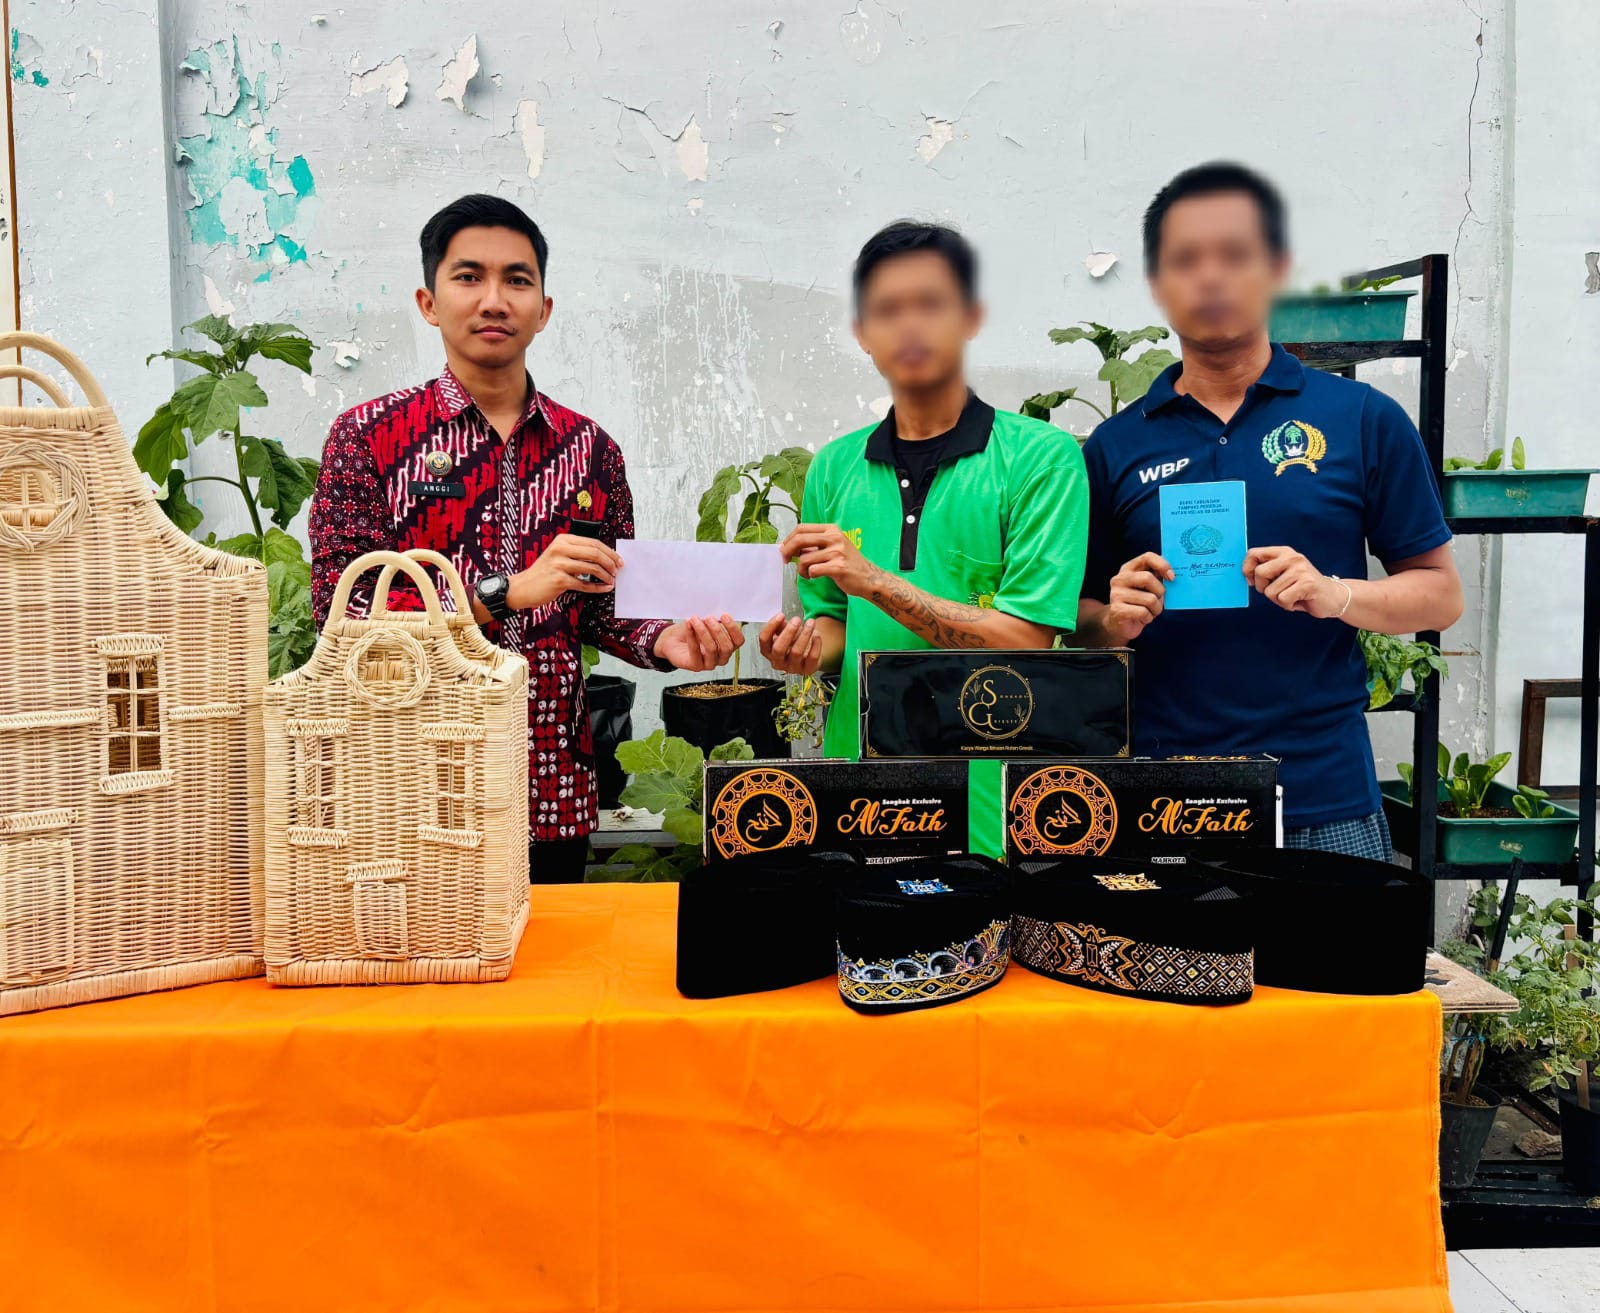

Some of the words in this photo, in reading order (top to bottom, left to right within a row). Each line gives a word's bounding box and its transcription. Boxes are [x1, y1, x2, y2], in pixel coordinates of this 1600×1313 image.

[1139, 458, 1190, 484] WBP
[423, 484, 450, 493] ANGGI
[837, 798, 881, 836] Al
[879, 806, 948, 835] Fath
[1138, 796, 1183, 834] Al
[1182, 806, 1254, 834] Fath
